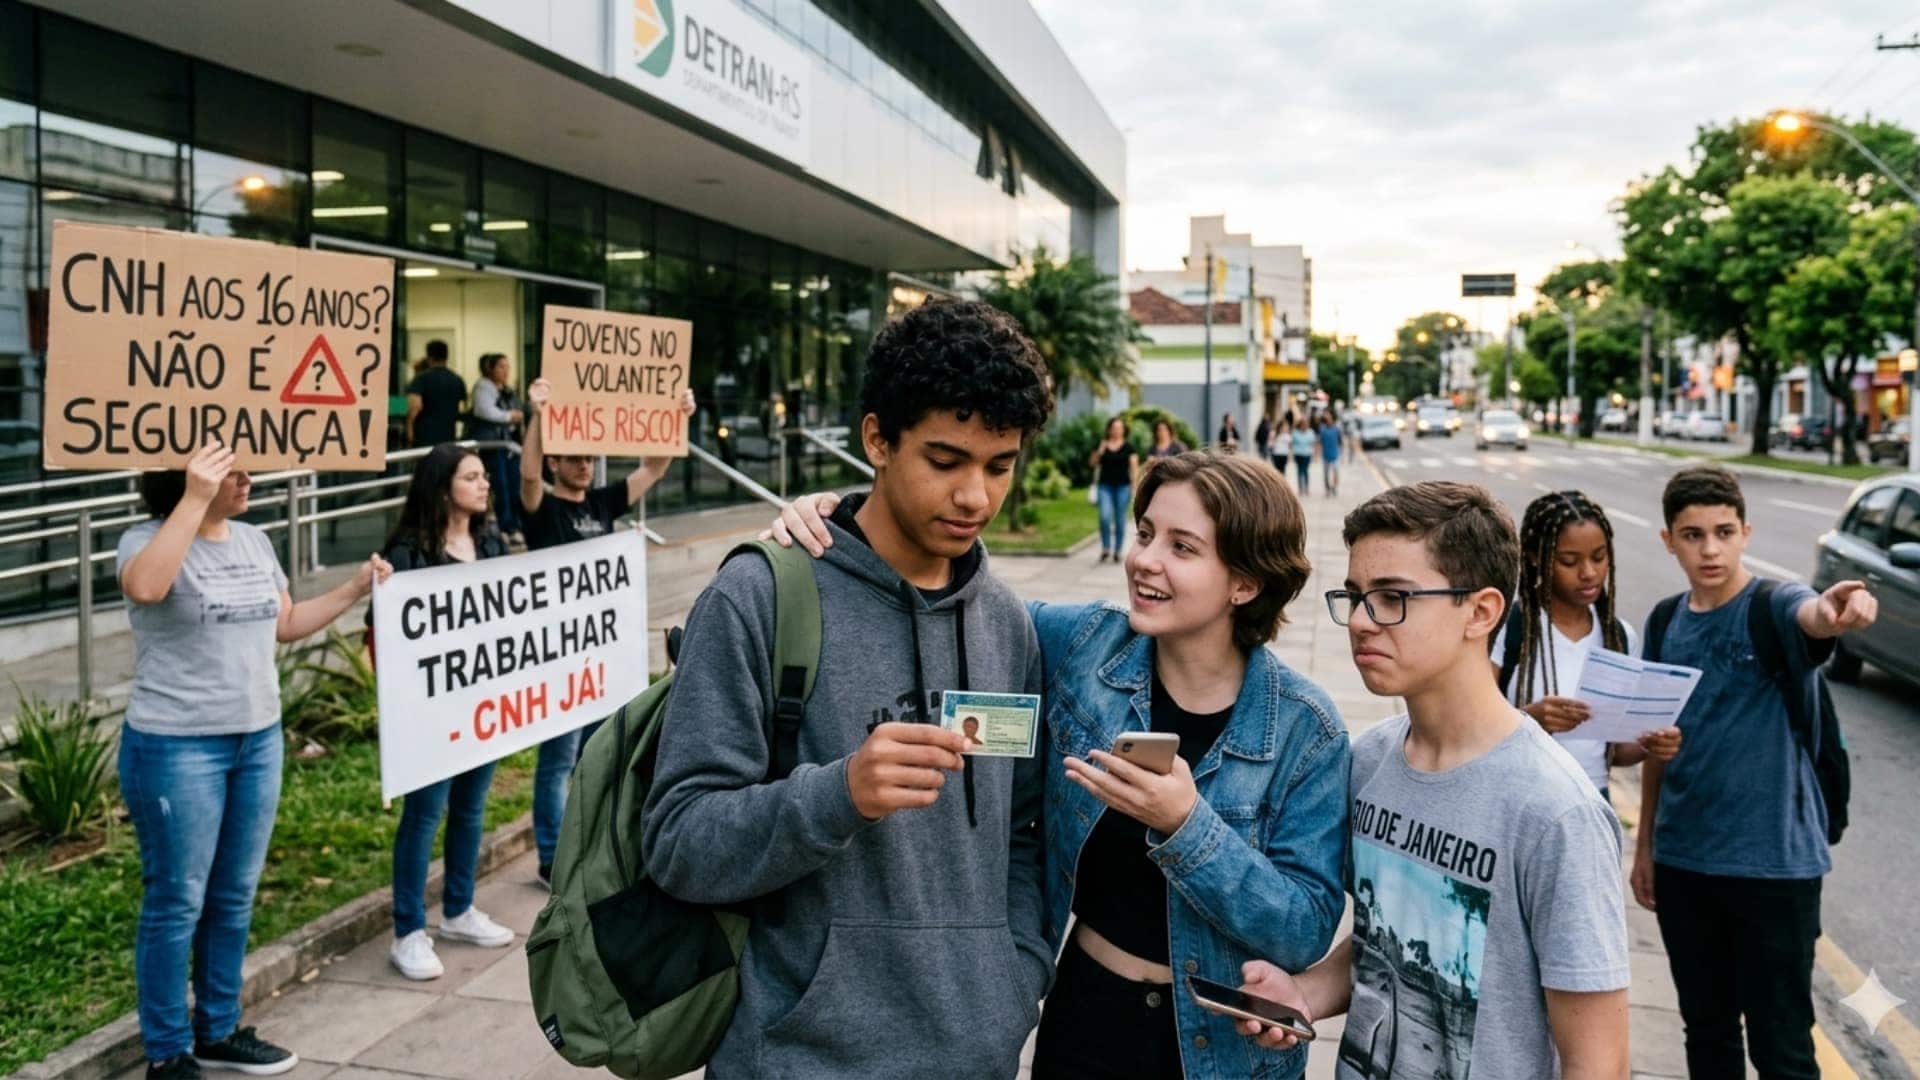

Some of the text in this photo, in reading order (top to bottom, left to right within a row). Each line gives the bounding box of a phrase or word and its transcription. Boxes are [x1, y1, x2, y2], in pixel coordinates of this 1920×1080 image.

[684, 15, 800, 120] DETRAN-RS
[62, 252, 391, 334] CNH AOS 16 ANOS?
[128, 330, 225, 390] NÃO
[249, 334, 275, 391] É
[552, 318, 677, 359] JOVENS NO
[574, 362, 683, 399] VOLANTE?
[401, 555, 630, 640] CHANCE PARA
[418, 608, 618, 698] TRABALHAR
[473, 682, 547, 741] CNH
[559, 657, 605, 712] JÁ!
[1374, 808, 1402, 846] DE
[1400, 819, 1497, 883] JANEIRO
